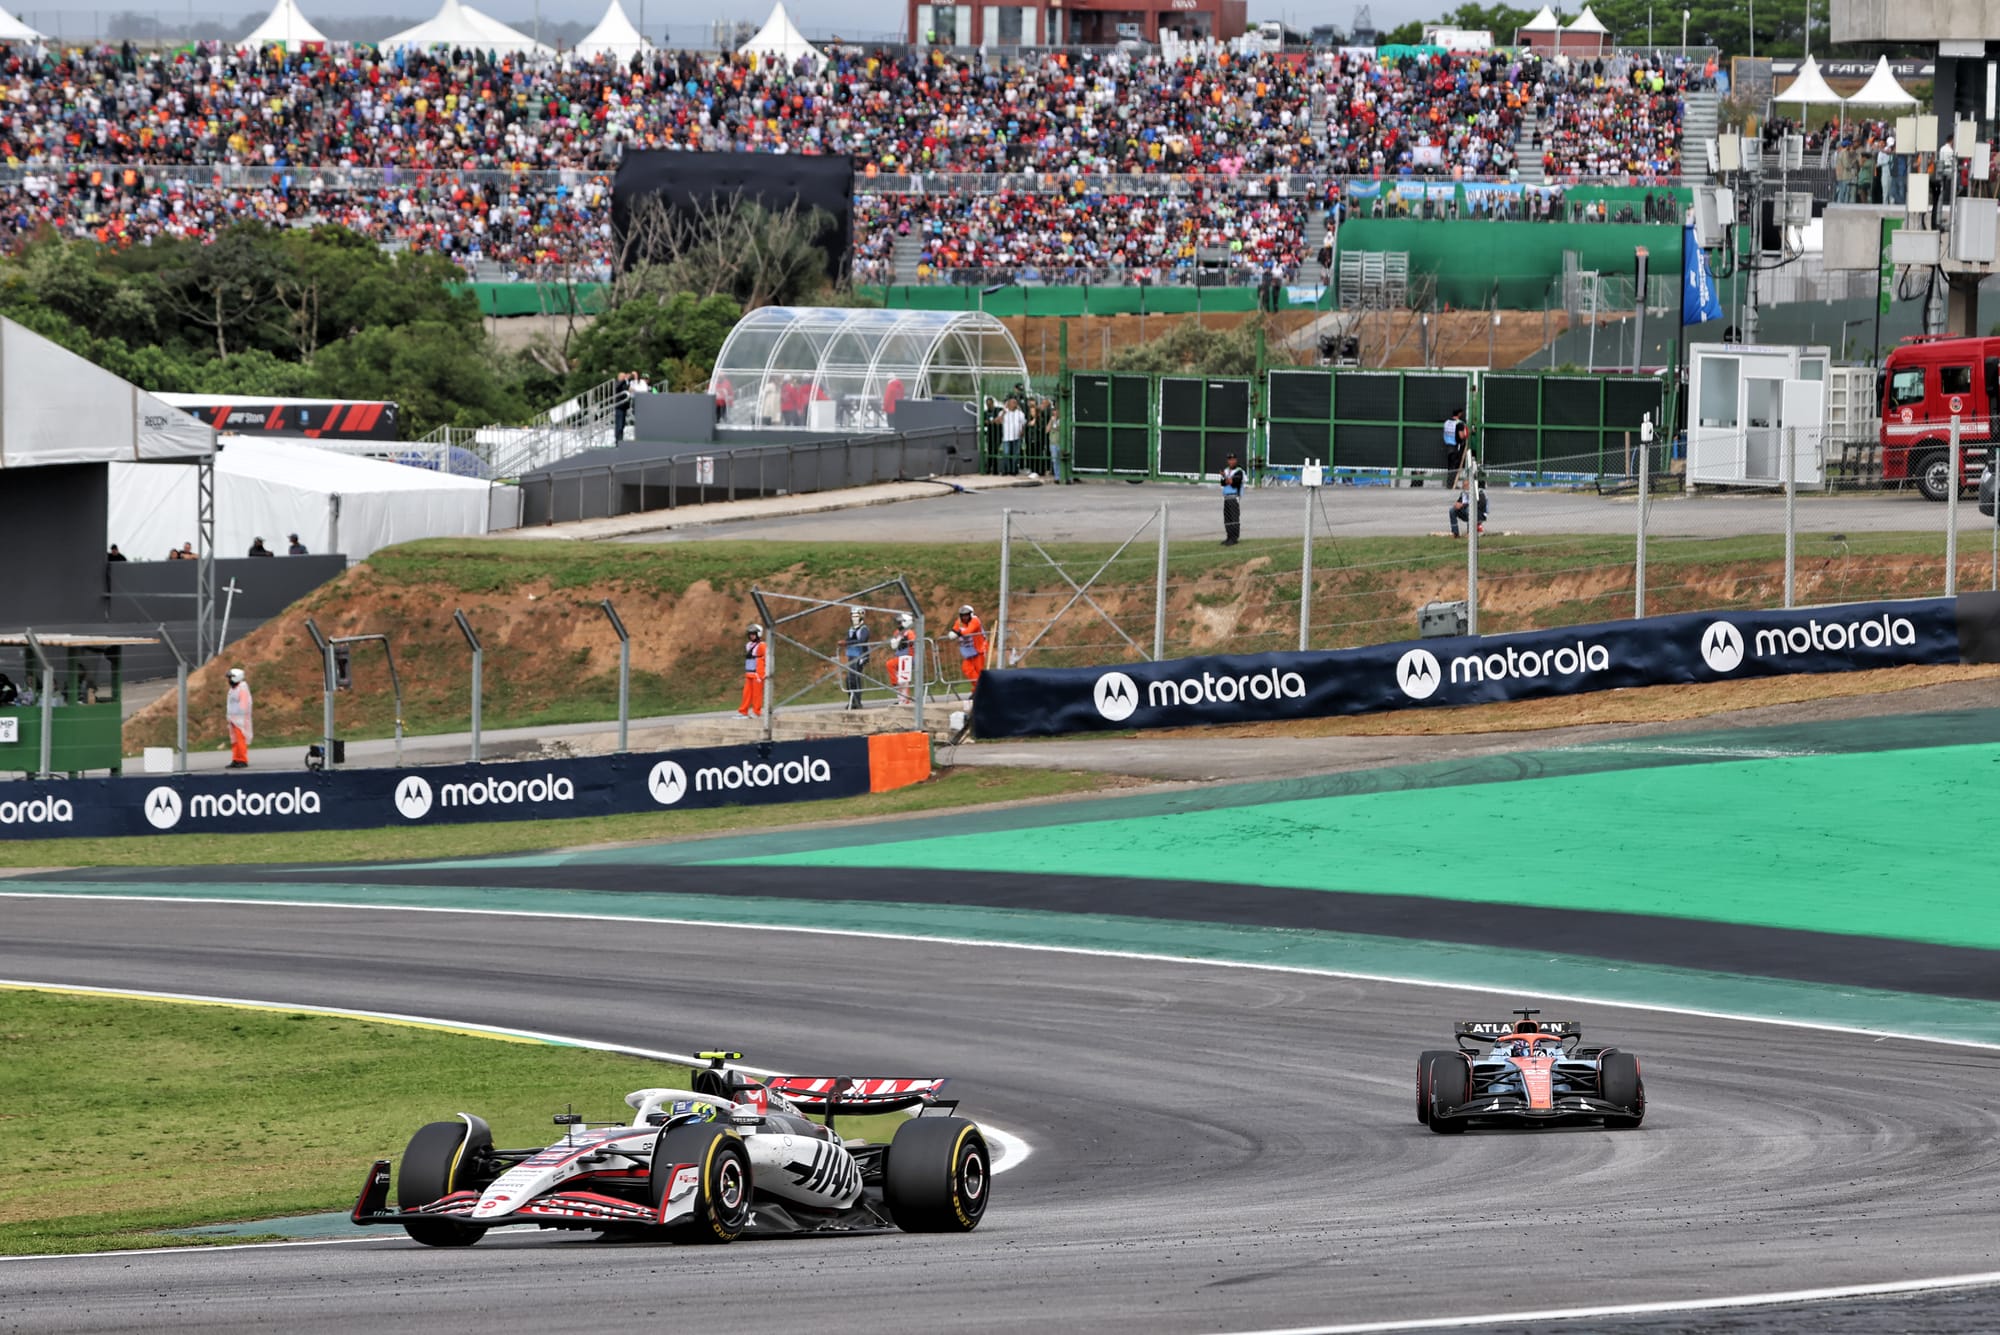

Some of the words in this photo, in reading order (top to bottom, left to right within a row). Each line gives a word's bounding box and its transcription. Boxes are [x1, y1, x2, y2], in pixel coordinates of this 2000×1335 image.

[1828, 63, 1915, 75] FANZNE
[1755, 613, 1916, 657] motorola
[1450, 640, 1609, 684] motorola
[1148, 667, 1306, 707] motorola
[440, 773, 574, 807] motorola
[695, 755, 831, 792] motorola
[190, 786, 321, 818] motorola
[1472, 1023, 1563, 1034] ATLAAN
